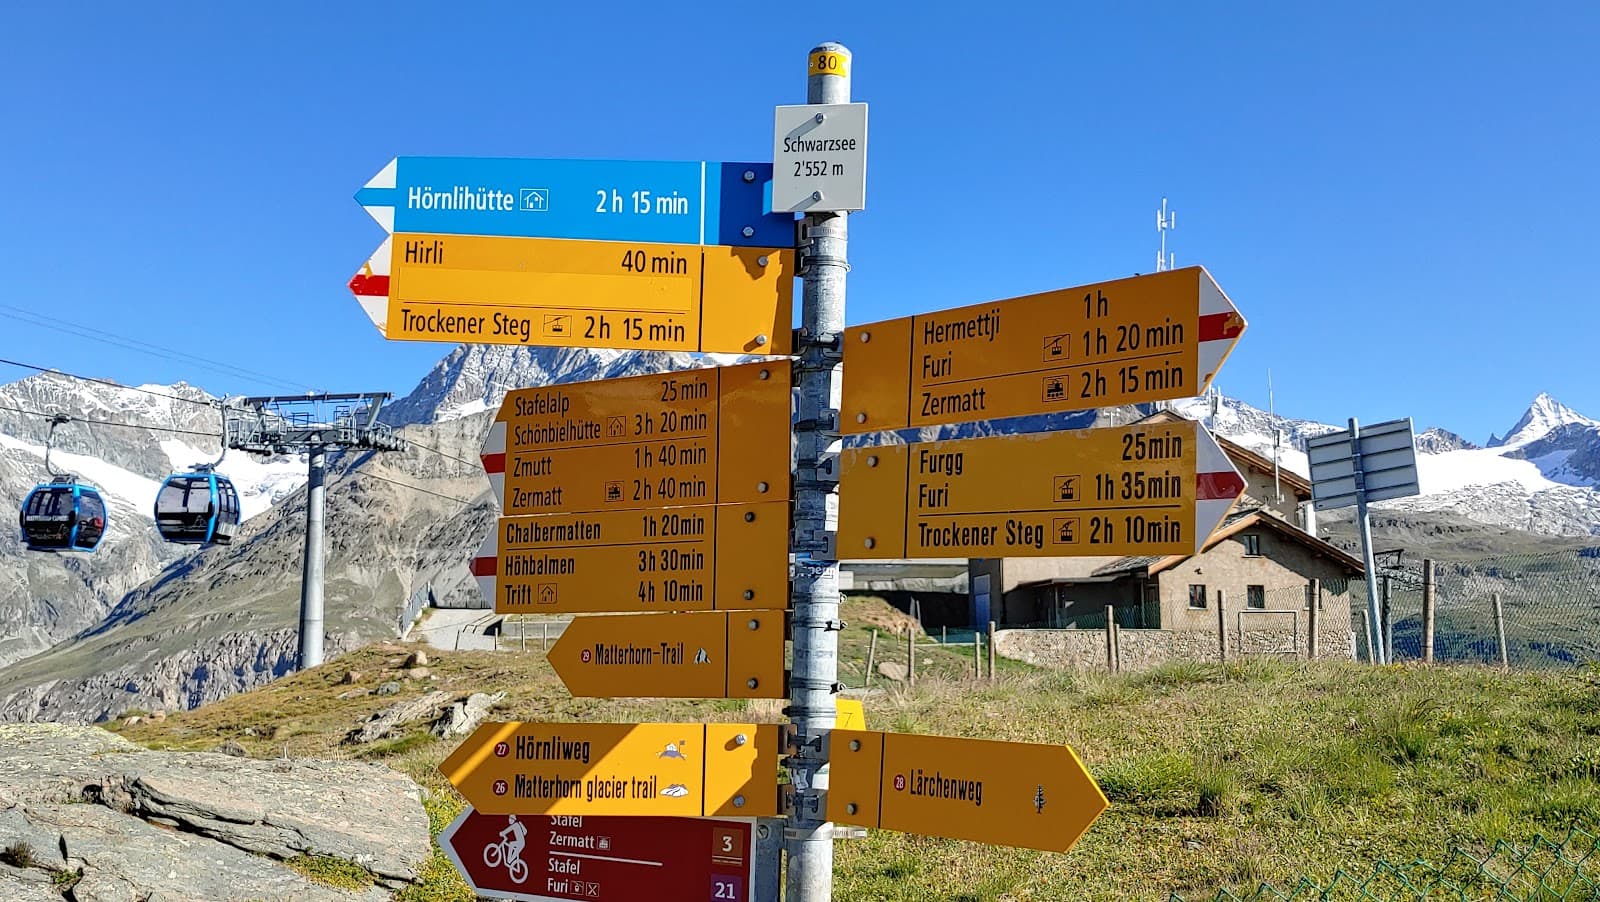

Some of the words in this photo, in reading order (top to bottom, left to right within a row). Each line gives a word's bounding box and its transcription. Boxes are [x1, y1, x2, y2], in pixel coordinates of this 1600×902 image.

[818, 56, 837, 70] 80
[784, 136, 856, 152] Schwarzsee
[794, 161, 826, 177] 2'552
[832, 163, 843, 175] m
[408, 186, 513, 212] Hörnlihütte
[633, 191, 651, 214] 15
[656, 192, 688, 214] min
[405, 241, 443, 265] Hirli
[622, 250, 645, 273] 40
[652, 251, 687, 275] min
[401, 310, 485, 336] Trockener
[493, 313, 530, 341] Steg
[624, 318, 643, 340] 15
[649, 318, 685, 342] min
[924, 309, 1001, 345] Hermettji
[923, 351, 952, 380] Furi
[515, 391, 569, 417] Stafelalp
[922, 388, 985, 417] Zermatt
[514, 420, 600, 446] Schönbielhütte
[514, 457, 551, 477] Zmutt
[920, 450, 963, 476] Furgg
[513, 487, 562, 508] Zermatt
[919, 484, 949, 509] Furi
[506, 521, 601, 544] Chalbermatten
[919, 522, 997, 548] Trockener
[1006, 519, 1043, 549] Steg
[505, 555, 575, 576] Höhbalmen
[505, 584, 531, 605] Trift
[582, 651, 590, 662] 29
[497, 743, 506, 755] 27
[516, 736, 590, 765] Hörnliweg
[496, 782, 505, 793] 26
[514, 774, 581, 800] Matterhorn
[587, 775, 626, 802] glacier
[631, 775, 656, 799] trail
[895, 777, 904, 788] 28
[910, 769, 982, 806] Lärchenweg
[549, 831, 594, 849] Zermatt
[722, 836, 733, 852] 3
[548, 858, 580, 875] Stafel
[547, 878, 568, 893] Furi
[714, 883, 735, 899] 21
